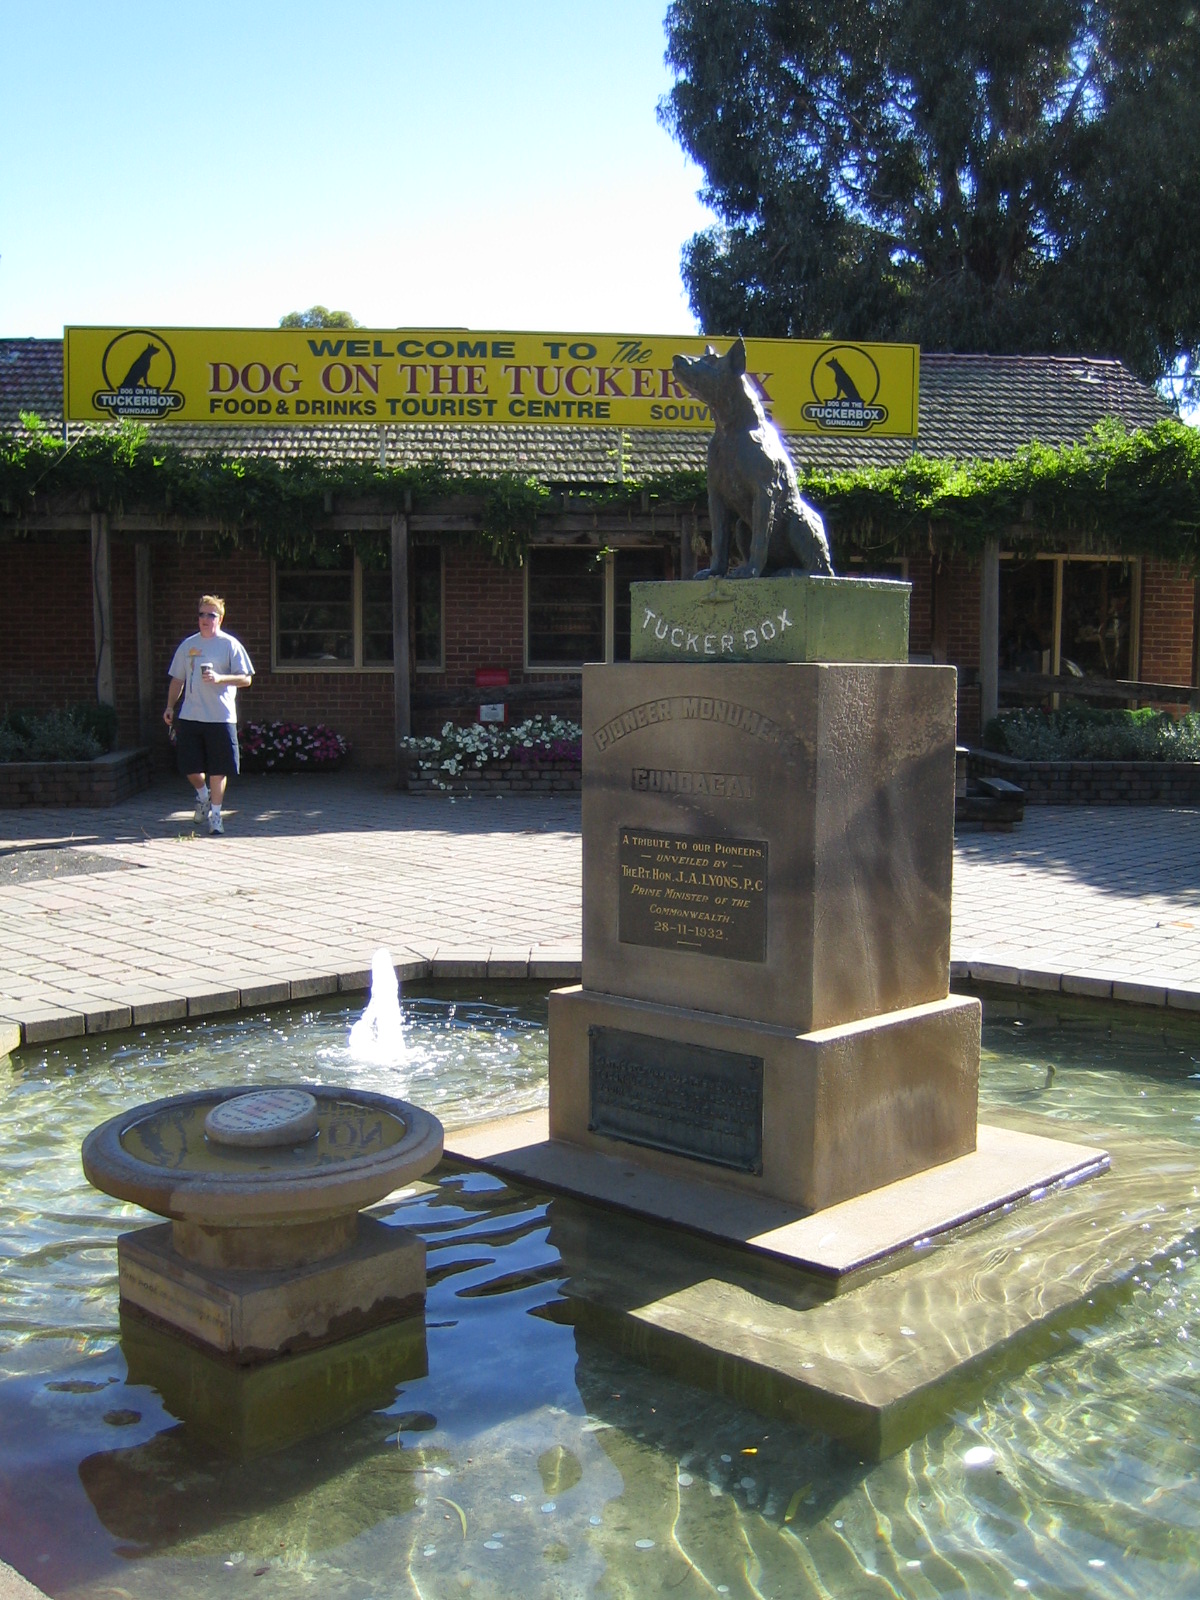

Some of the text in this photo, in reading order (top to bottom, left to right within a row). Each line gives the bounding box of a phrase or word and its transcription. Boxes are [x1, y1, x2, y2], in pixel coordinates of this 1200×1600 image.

[307, 339, 654, 365] WELCOME TO The
[120, 387, 133, 395] DOG
[135, 387, 144, 395] ON
[208, 361, 775, 402] DOG ON THE TUCKERX
[101, 395, 175, 406] TUCKERBOX
[209, 398, 274, 415] FOOD
[295, 399, 377, 417] DRINKS
[386, 398, 497, 416] TOURIST
[508, 400, 611, 418] CENTRE
[827, 400, 840, 408] DOG
[118, 407, 159, 415] GUNDAGAI
[810, 407, 879, 420] TUCKERBOX
[825, 419, 864, 427] GUNDAGAI
[641, 607, 794, 655] TUCKER BOX
[593, 698, 673, 752] PIONEER
[633, 768, 753, 799] GUNDAGAI
[622, 834, 630, 845] A
[632, 836, 671, 850] TRIBUTE
[675, 840, 688, 850] TO
[692, 841, 711, 853] OUR
[656, 854, 729, 869] UNVEILED BY
[630, 884, 751, 908] PRIME MINISTER OF THE
